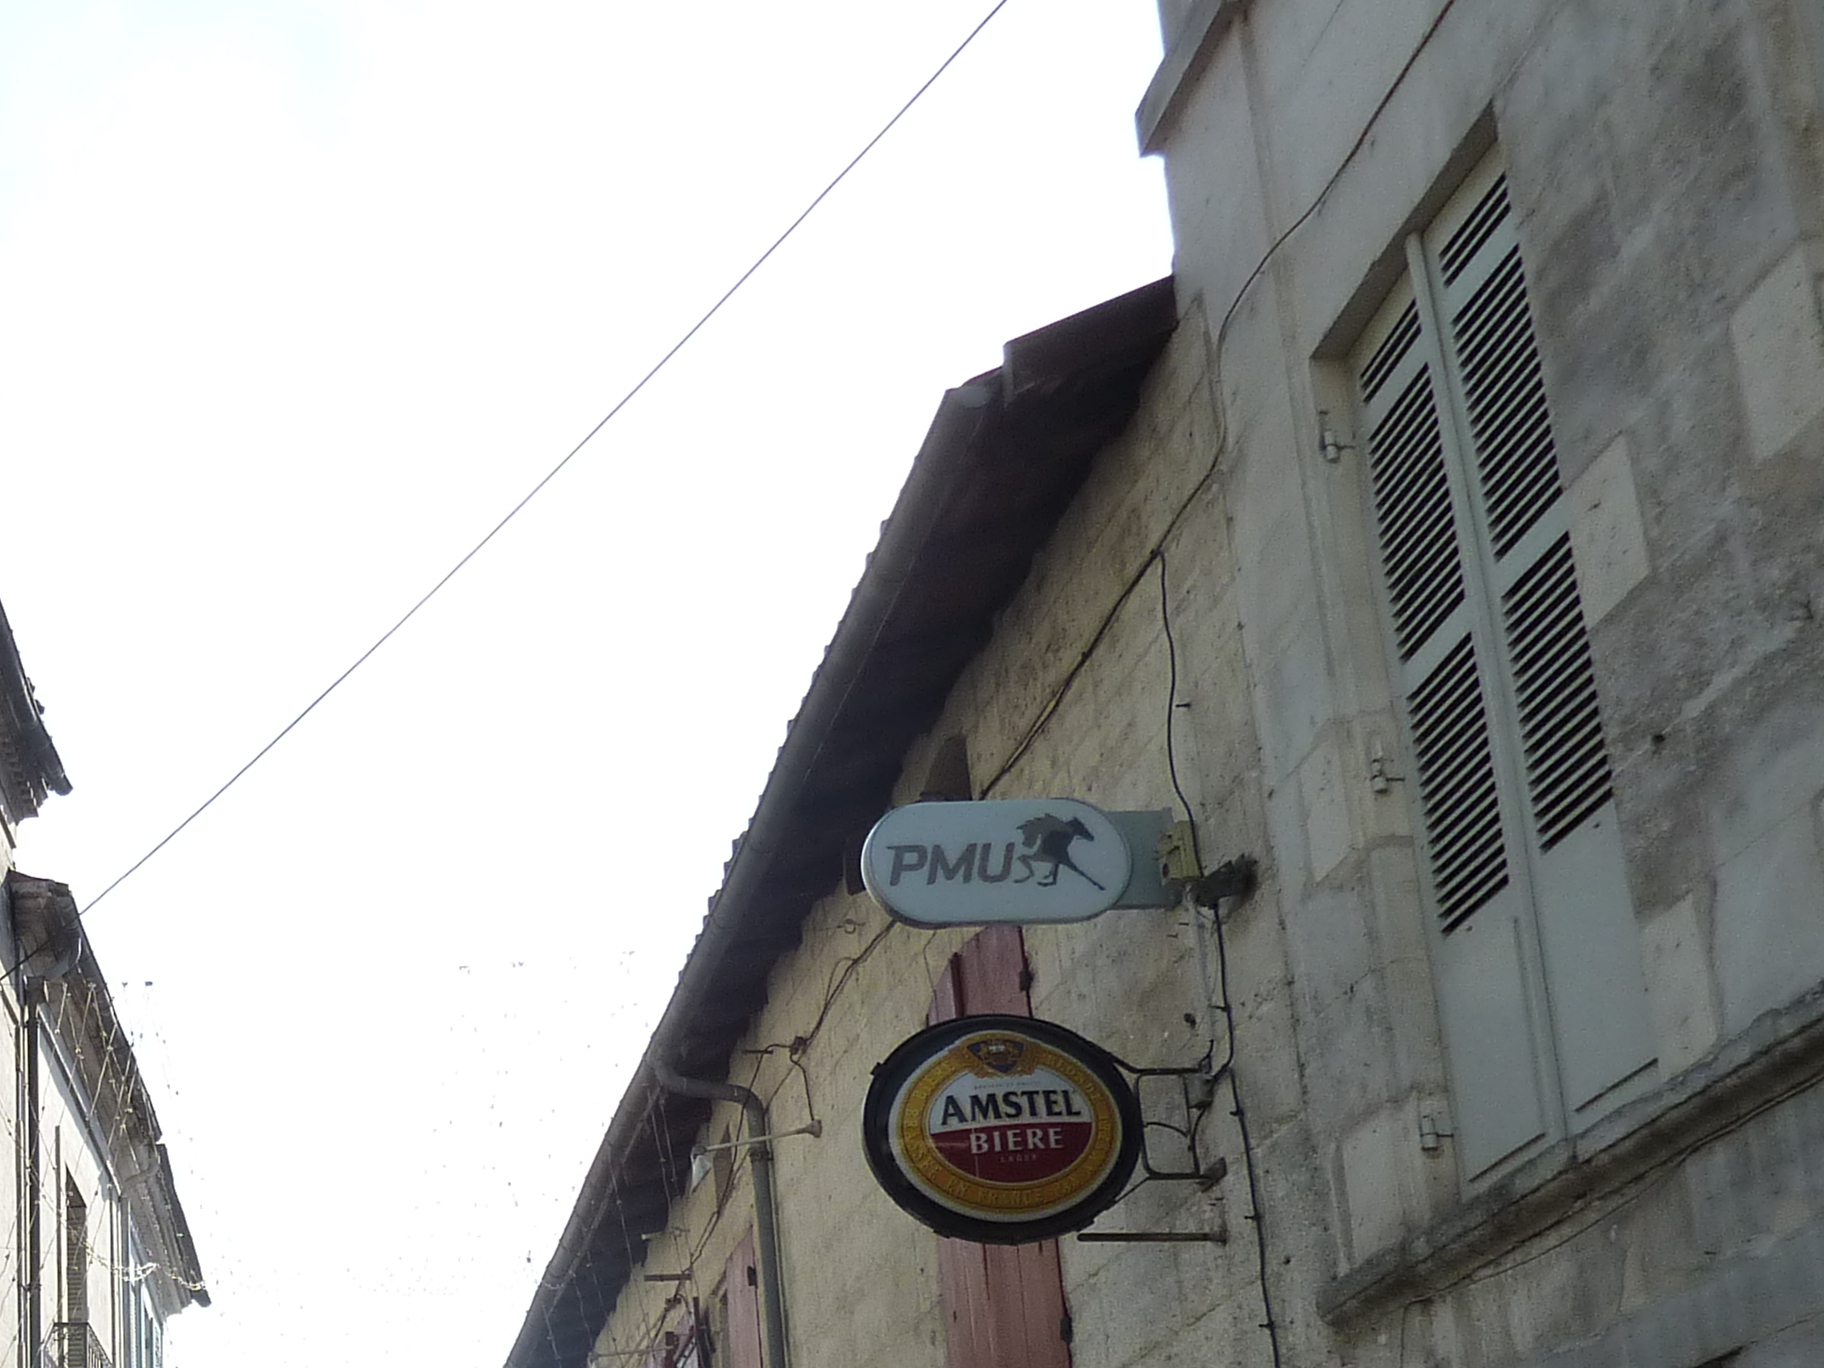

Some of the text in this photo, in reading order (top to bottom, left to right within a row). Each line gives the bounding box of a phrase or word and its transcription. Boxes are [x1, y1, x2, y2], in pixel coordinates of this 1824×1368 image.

[887, 842, 1015, 887] PMU
[941, 1090, 1082, 1126] AMSTEL
[969, 1127, 1065, 1155] BIERE
